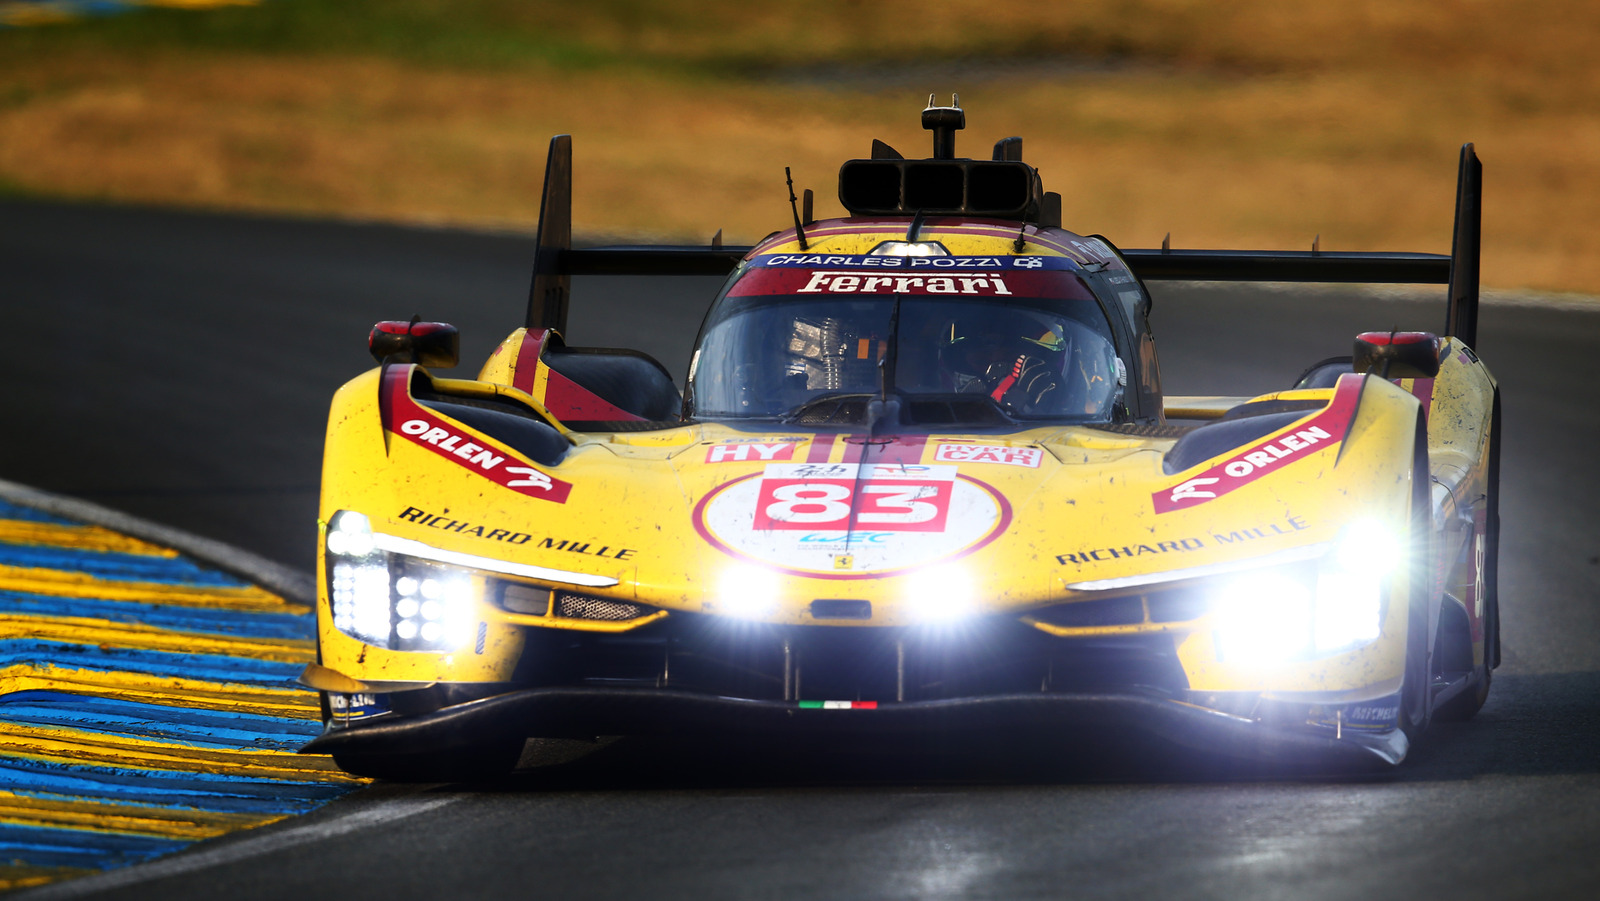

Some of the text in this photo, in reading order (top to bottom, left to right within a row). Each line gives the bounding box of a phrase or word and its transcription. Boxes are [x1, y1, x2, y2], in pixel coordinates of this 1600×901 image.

[766, 255, 1003, 267] CHARLES POZZI
[796, 270, 1013, 295] Ferrari
[401, 419, 505, 470] ORLEN
[709, 443, 791, 463] HY
[943, 450, 1032, 465] CAR
[1224, 425, 1332, 478] ORLEN
[765, 483, 939, 524] 83
[398, 506, 639, 561] RICHARD MILLE
[799, 532, 896, 543] WEC
[1055, 516, 1311, 566] RICHARD MILLE
